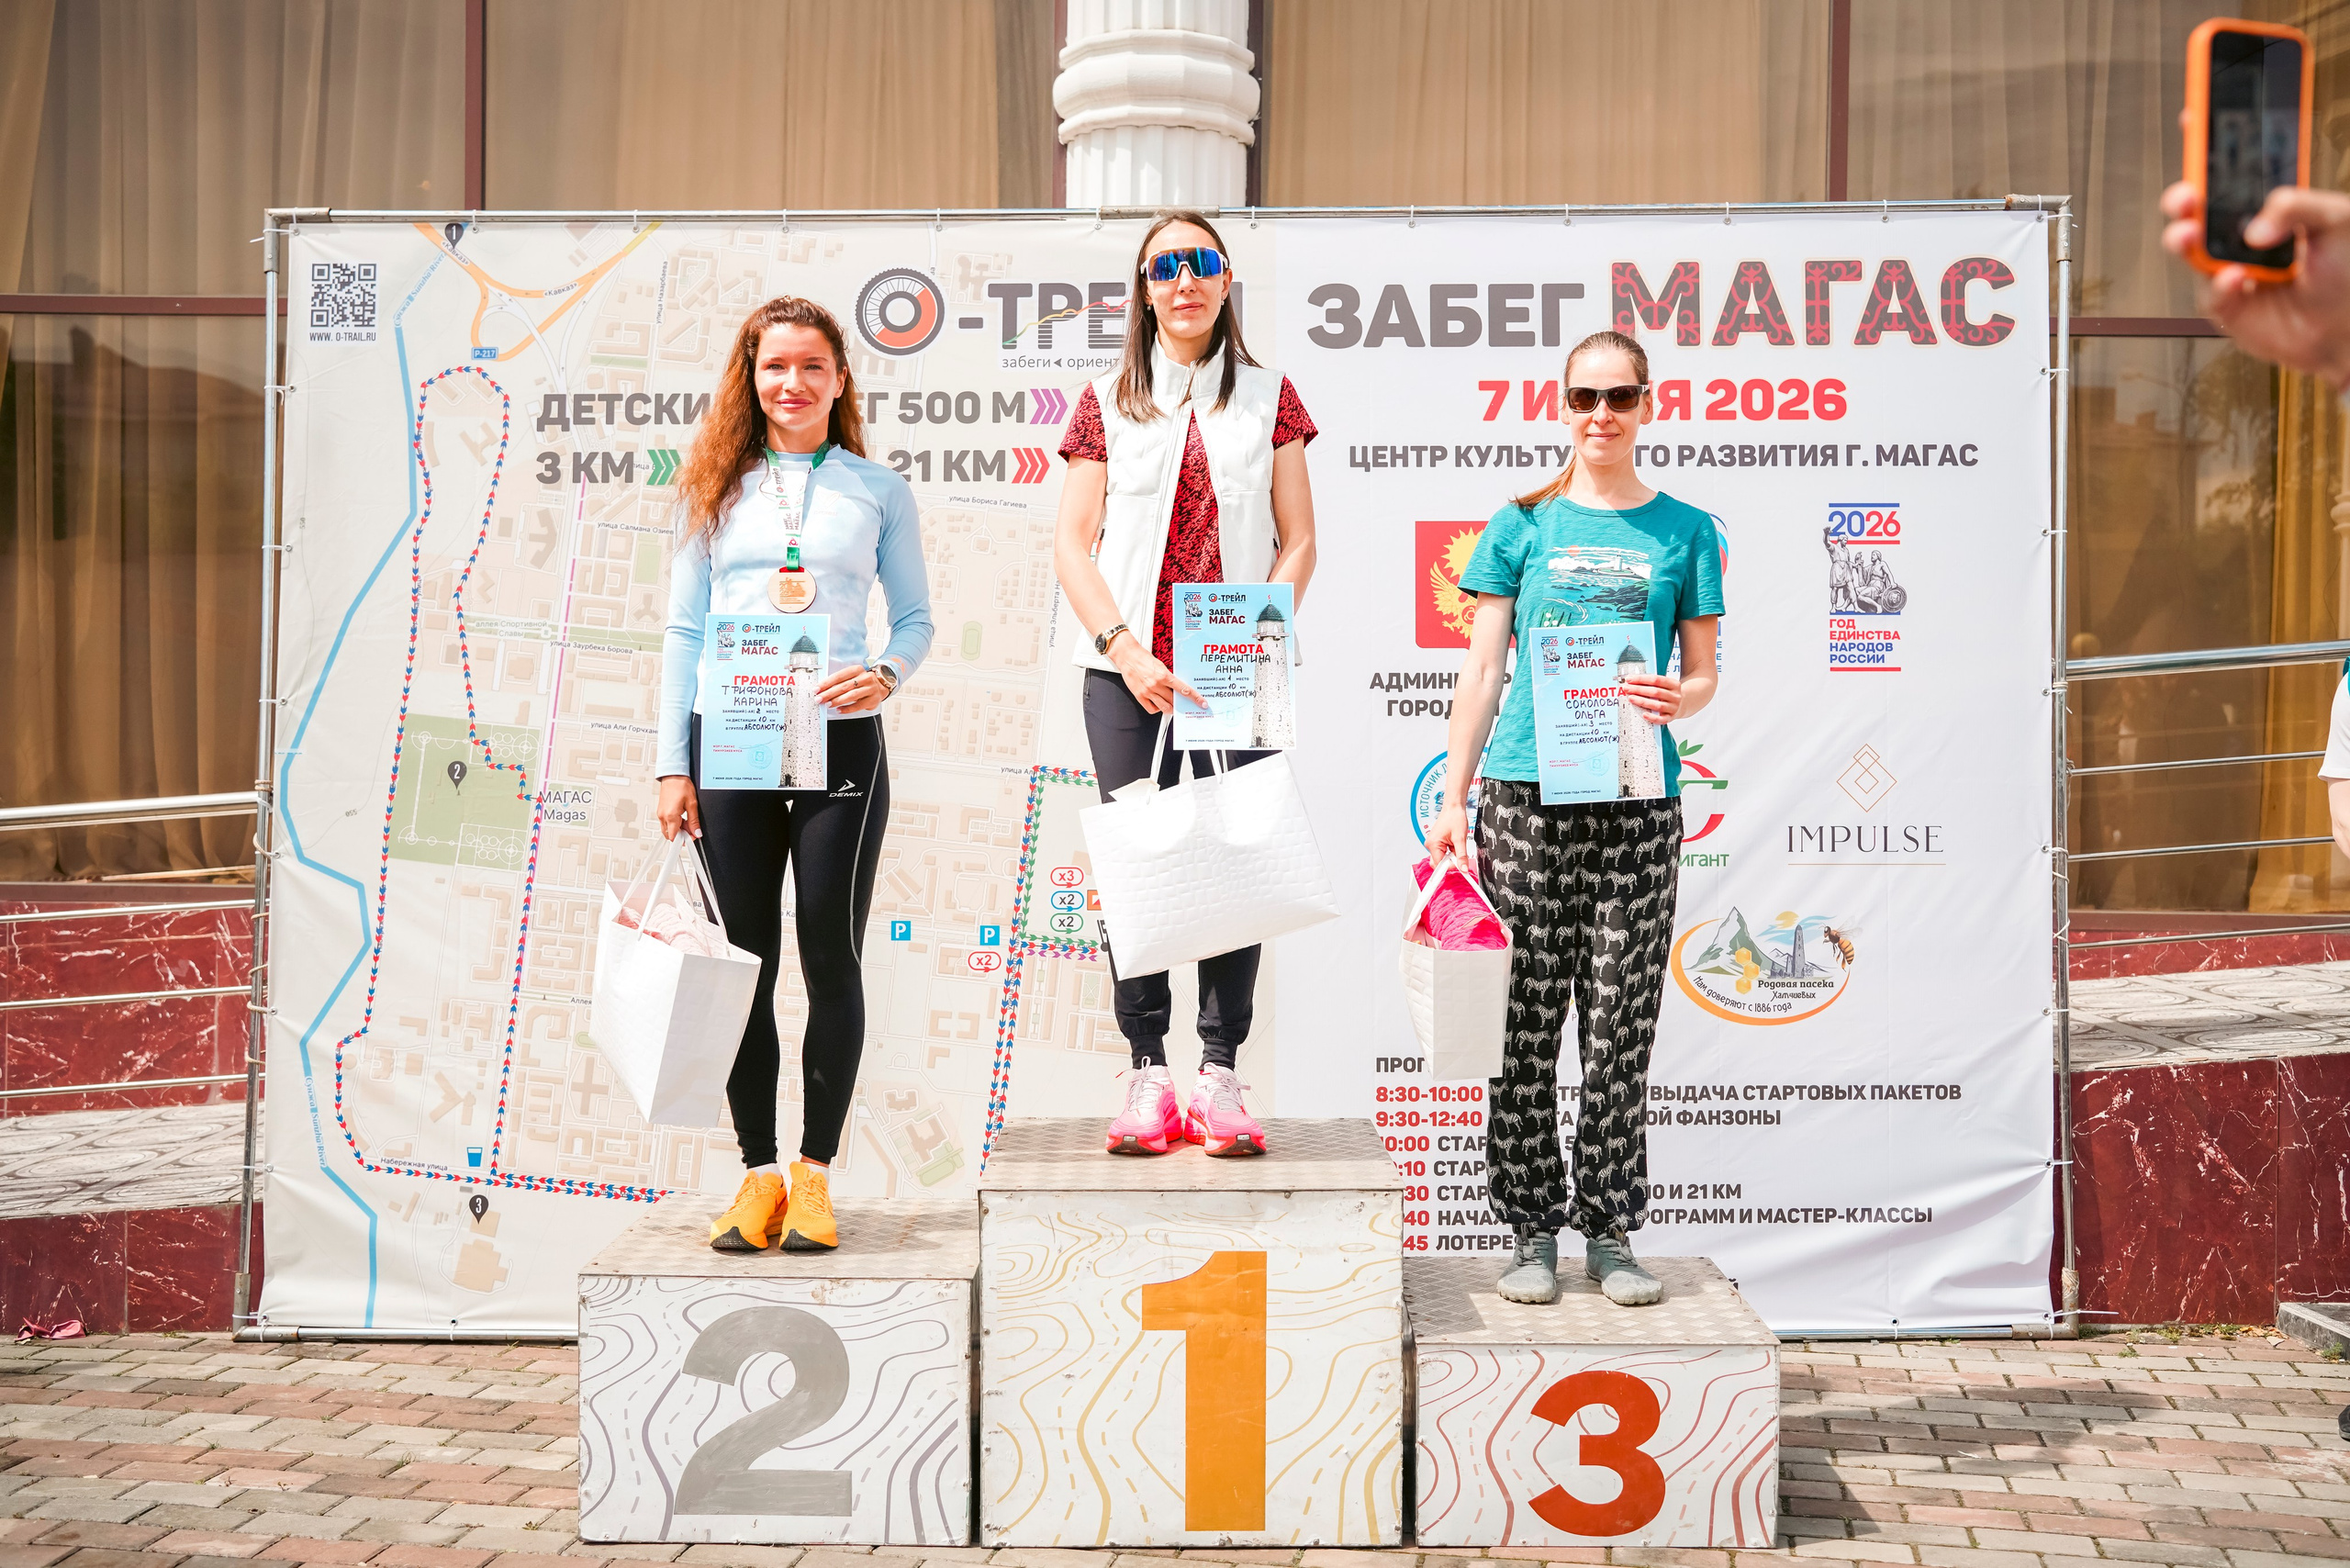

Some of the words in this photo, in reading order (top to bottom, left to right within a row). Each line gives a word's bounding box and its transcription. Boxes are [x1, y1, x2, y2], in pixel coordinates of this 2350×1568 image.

[543, 282, 577, 297] «Кавказ»
[1306, 283, 1585, 350] ЗАБЕГ
[1610, 256, 2018, 348] МАГАС
[1002, 355, 1051, 369] забеги
[1067, 357, 1121, 371] ориент
[1478, 380, 1510, 421] 7
[1705, 377, 1848, 422] 2026
[536, 392, 711, 432] ДЕТСКИ
[897, 390, 981, 425] 500
[991, 391, 1026, 424] М
[1349, 445, 1449, 473] ЦЕНТР
[1677, 443, 1834, 467] РАЗВИТИЯ
[1845, 443, 1869, 467] Г.
[1875, 442, 1979, 467] МАГАС
[536, 451, 562, 485] 3
[572, 451, 634, 484] КМ
[887, 449, 932, 483] 21
[943, 449, 1007, 483] КМ
[971, 496, 998, 505] Бориса
[999, 499, 1027, 509] Гагиева
[597, 521, 619, 530] улица
[620, 523, 651, 532] Салмана
[652, 526, 675, 535] Озиев
[1828, 510, 1902, 537] 2026
[1209, 615, 1246, 624] МАГАС
[1829, 619, 1856, 630] ГОД
[1541, 637, 1559, 645] 2026
[1829, 631, 1901, 642] ЕДИНСТВА
[549, 640, 571, 648] улица
[573, 641, 606, 652] Заурбека
[607, 645, 633, 655] Борова
[741, 646, 778, 655] МАГАС
[1203, 644, 1264, 655] ГРАМОТА
[1829, 643, 1894, 654] НАРОДОВ
[1566, 652, 1594, 660] ЗАБЕГ
[1567, 658, 1606, 668] МАГАС
[1829, 655, 1886, 664] РОССИИ
[1214, 665, 1243, 674] АННА
[733, 675, 796, 686] ГРАМОТА
[1563, 687, 1627, 700] ГРАМОТА
[733, 697, 778, 707] КАРИНА
[1574, 710, 1606, 720] ОЛЬГА
[628, 725, 659, 734] Горчхан
[1001, 767, 1023, 775] улица
[539, 790, 592, 804] МАГАС
[1418, 769, 1443, 818] ИСТОЧНИК
[543, 810, 587, 823] Magas
[1787, 824, 1944, 854] IMPULSE
[1679, 852, 1731, 868] игант
[1058, 869, 1075, 881] x3
[1058, 893, 1075, 905] x2
[1058, 915, 1074, 927] x2
[975, 954, 992, 967] x2
[1757, 980, 1797, 991] Родовая
[1799, 980, 1834, 989] пасека
[1693, 975, 1707, 992] Нам
[1706, 989, 1747, 1010] доверяют
[1754, 1002, 1772, 1013] 1886
[1773, 1002, 1793, 1014] года
[1376, 1085, 1483, 1103] 8:30-10:00
[1648, 1084, 1736, 1104] ВЫДАЧА
[1742, 1084, 1866, 1102] СТАРТОВЫХ
[1871, 1084, 1962, 1101] ПАКЕТОВ
[1376, 1111, 1483, 1127] 9:30-12:40
[1676, 1109, 1782, 1126] ФАНЗОНЫ
[1438, 1136, 1487, 1151] СТАР
[380, 1157, 425, 1169] Набережная
[427, 1162, 448, 1171] улица
[1433, 1160, 1486, 1176] СТАР
[1438, 1185, 1488, 1201] СТАР
[1669, 1183, 1683, 1200] И
[1687, 1183, 1708, 1200] 21
[1712, 1183, 1742, 1200] КМ
[1648, 1208, 1735, 1225] ОГРАММ
[1739, 1208, 1753, 1224] И
[1757, 1206, 1933, 1225] МАСТЕР-КЛАССЫ
[1436, 1235, 1515, 1251] ЛОТЕРЕ
[1140, 1250, 1268, 1533] 1
[673, 1305, 852, 1518] 2
[1528, 1370, 1666, 1538] 3
